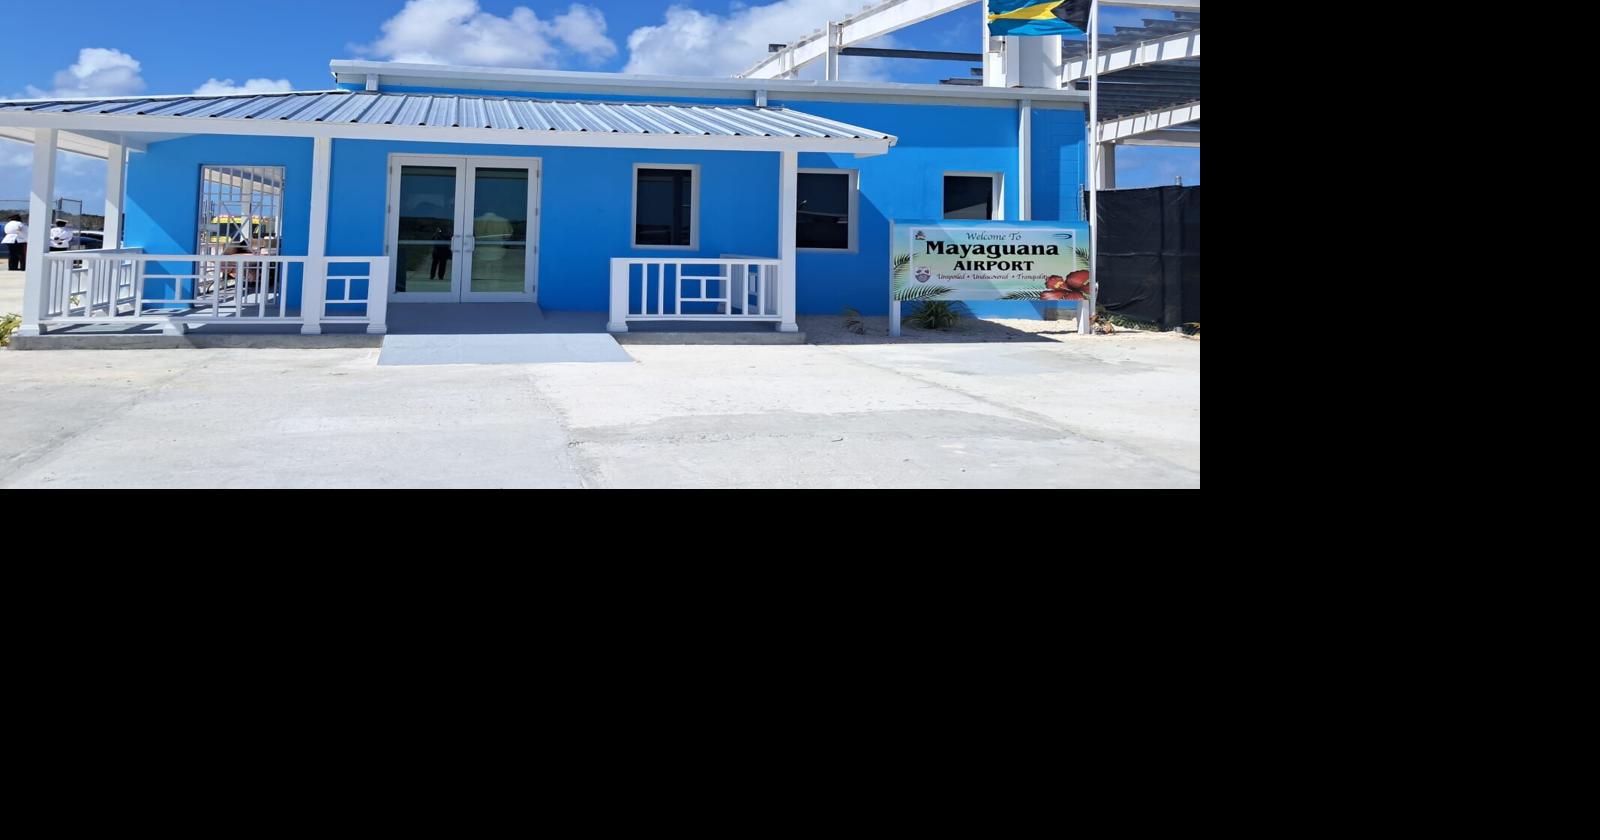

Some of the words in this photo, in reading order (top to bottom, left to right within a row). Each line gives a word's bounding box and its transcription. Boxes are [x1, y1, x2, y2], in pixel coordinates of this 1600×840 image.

[966, 231, 1005, 241] Welcome
[1008, 231, 1022, 241] To
[926, 240, 1059, 259] Mayaguana
[953, 260, 1034, 271] AIRPORT
